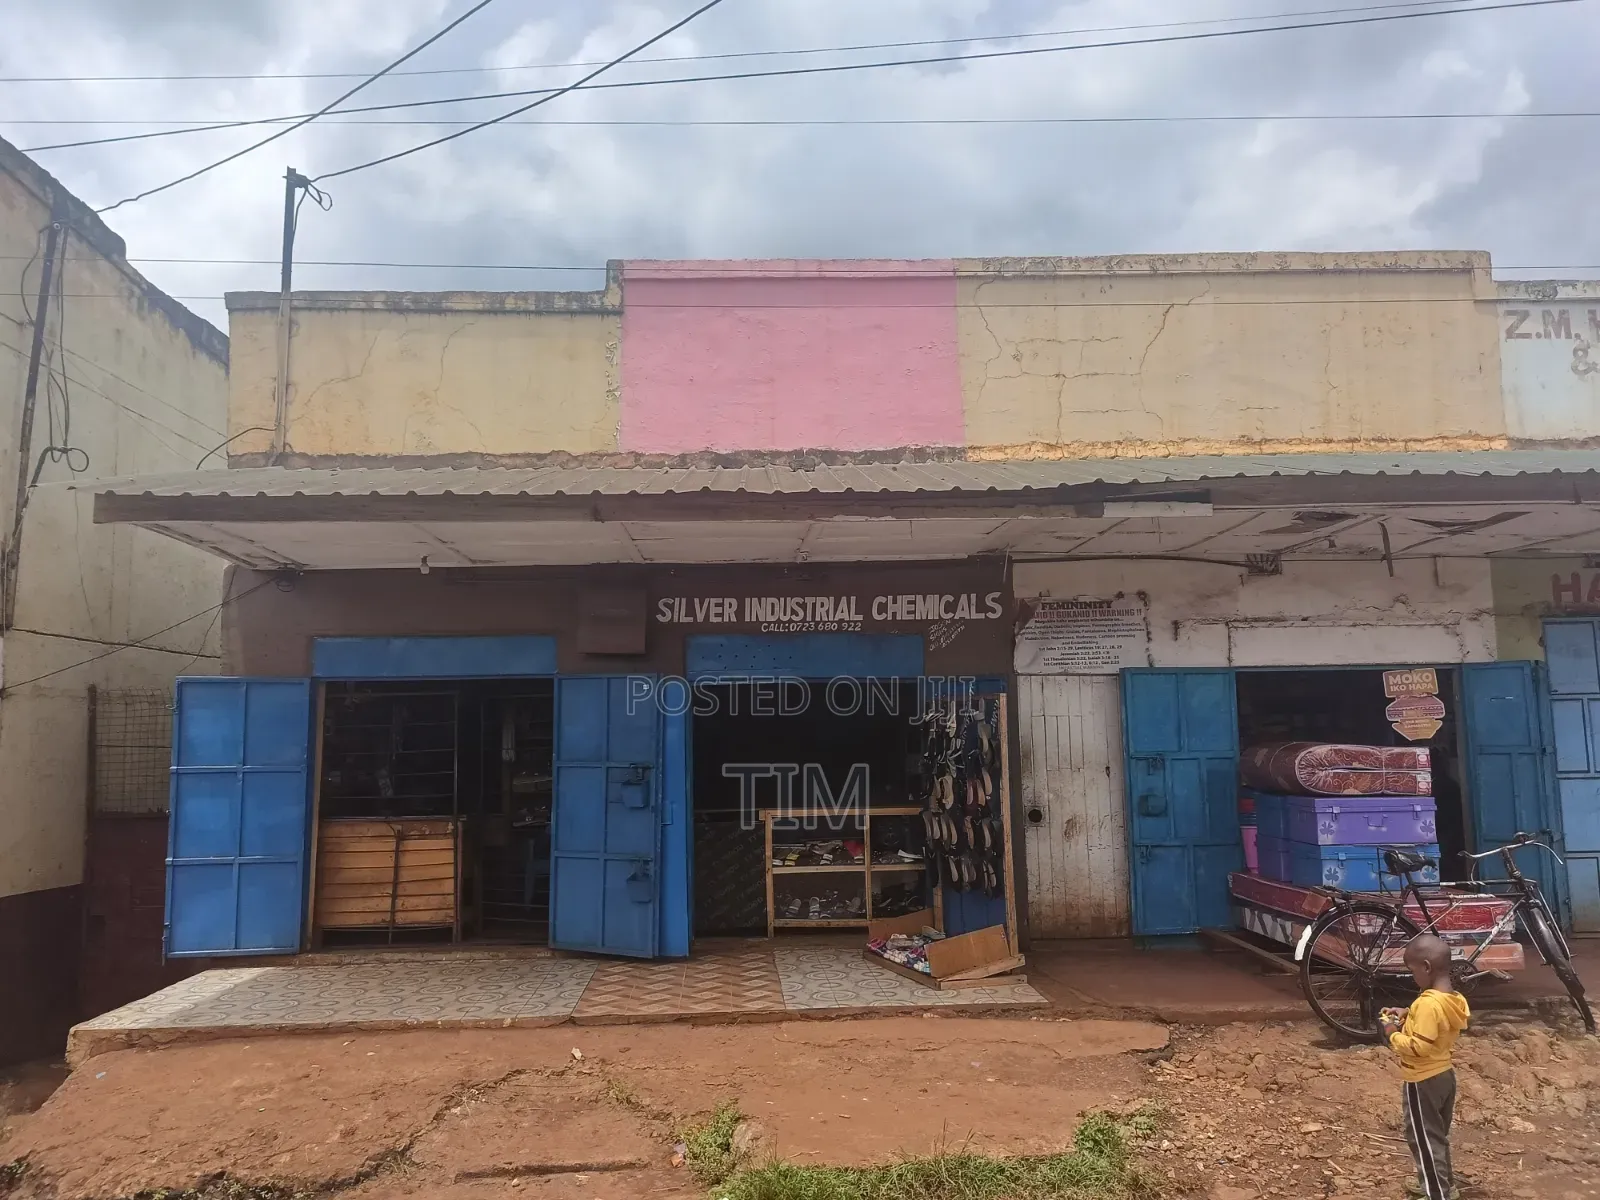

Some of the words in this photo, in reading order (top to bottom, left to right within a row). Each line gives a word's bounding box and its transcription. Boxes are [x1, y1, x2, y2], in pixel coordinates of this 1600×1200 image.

[656, 597, 738, 623] SILVER
[745, 596, 863, 622] INDUSTRIAL
[872, 592, 1003, 620] CHEMICALS
[1099, 609, 1134, 617] WARNING
[818, 622, 838, 631] 680
[841, 622, 862, 631] 922
[1388, 672, 1433, 685] MOKO
[1408, 683, 1433, 691] HAPA
